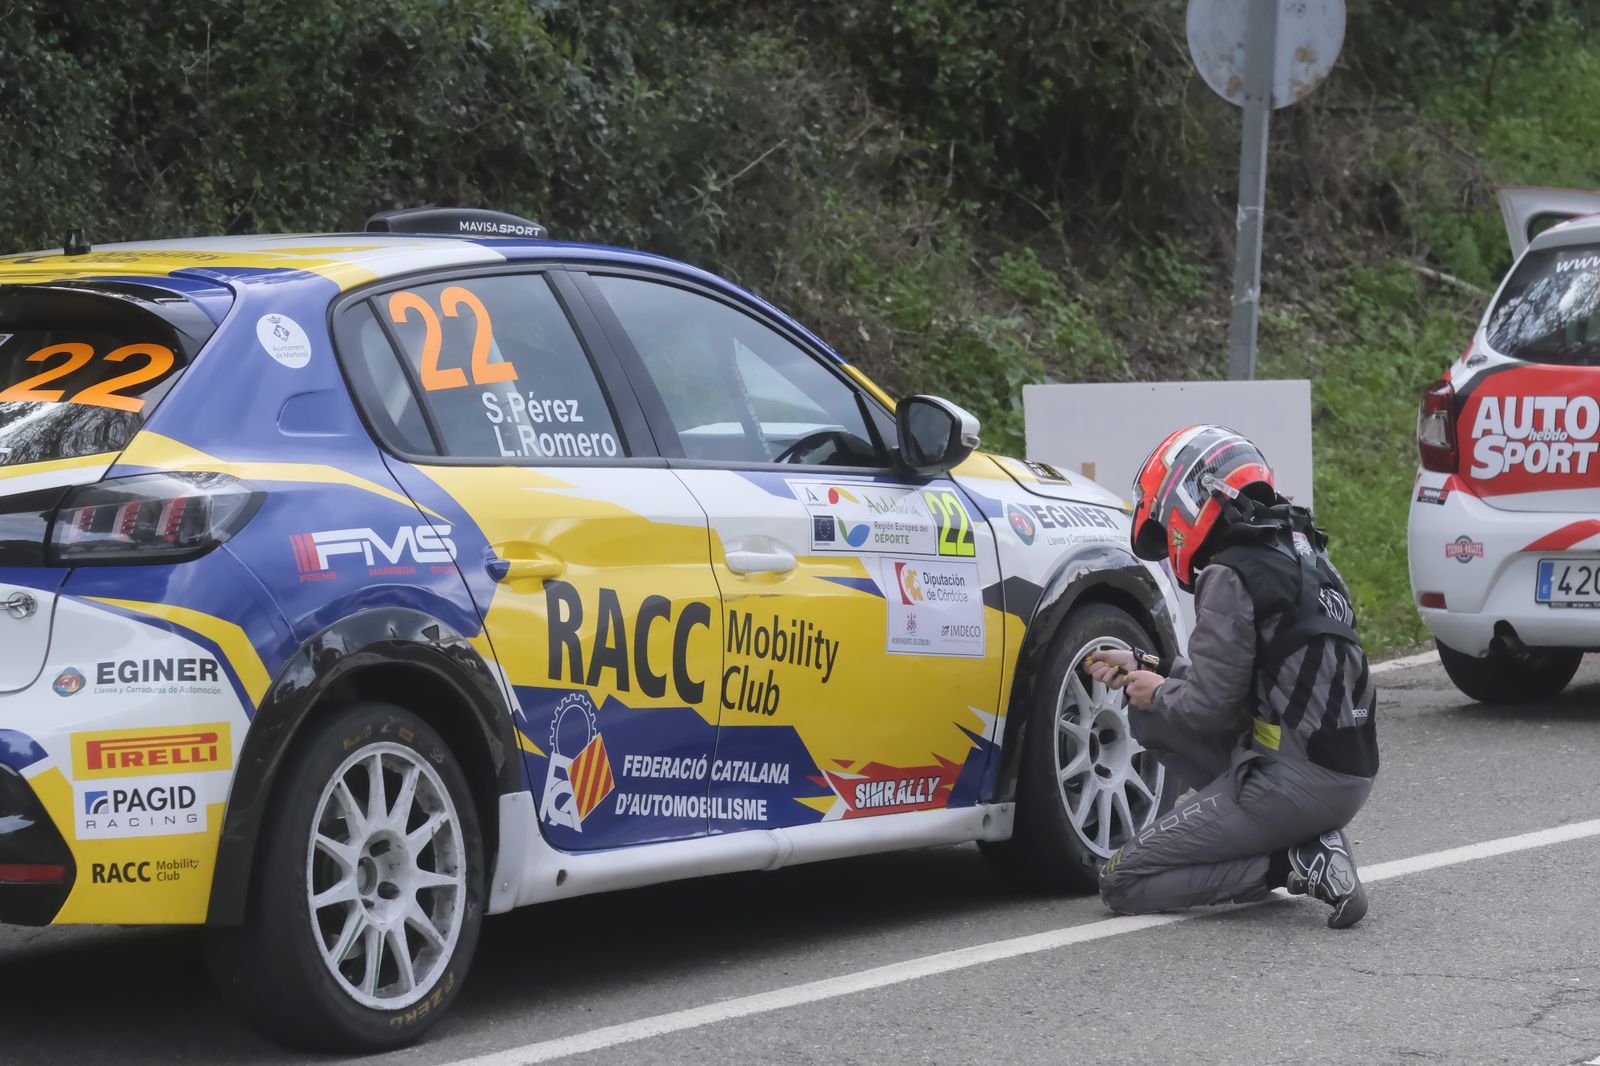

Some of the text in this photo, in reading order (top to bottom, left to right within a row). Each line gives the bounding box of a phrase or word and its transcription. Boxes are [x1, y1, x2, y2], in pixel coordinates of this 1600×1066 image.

[388, 286, 518, 391] 22
[0, 342, 175, 413] 22
[481, 391, 584, 424] S.Pérez
[1471, 395, 1600, 440] AUTO
[494, 425, 617, 457] L.Romero
[1528, 427, 1569, 441] hebdo
[1470, 434, 1599, 480] SPORT
[874, 521, 929, 533] Región Europea del
[923, 491, 975, 557] 22
[1029, 504, 1120, 530] EGINER
[312, 525, 457, 570] FMS
[875, 534, 910, 545] DEPORTE
[923, 571, 966, 588] Diputación
[927, 588, 968, 603] de Córdoba
[542, 579, 711, 704] RACC
[951, 625, 981, 638] IMDECO
[727, 609, 839, 684] Mobility
[97, 658, 219, 685] EGINER
[94, 686, 118, 695] Llaves
[125, 685, 167, 695] Cerraduras
[168, 685, 178, 694] de
[179, 685, 221, 695] Automoción
[722, 665, 781, 717] Club
[86, 732, 219, 770] PIRELLI
[622, 754, 790, 784] FEDERACIÓ CATALANA
[113, 785, 196, 813] PAGID
[855, 776, 942, 809] SIMRALLY
[615, 793, 768, 821] D'AUTOMOBILISME
[86, 813, 198, 830] RACING
[92, 861, 151, 883] RACC
[156, 858, 199, 871] Mobility
[156, 871, 180, 882] Club
